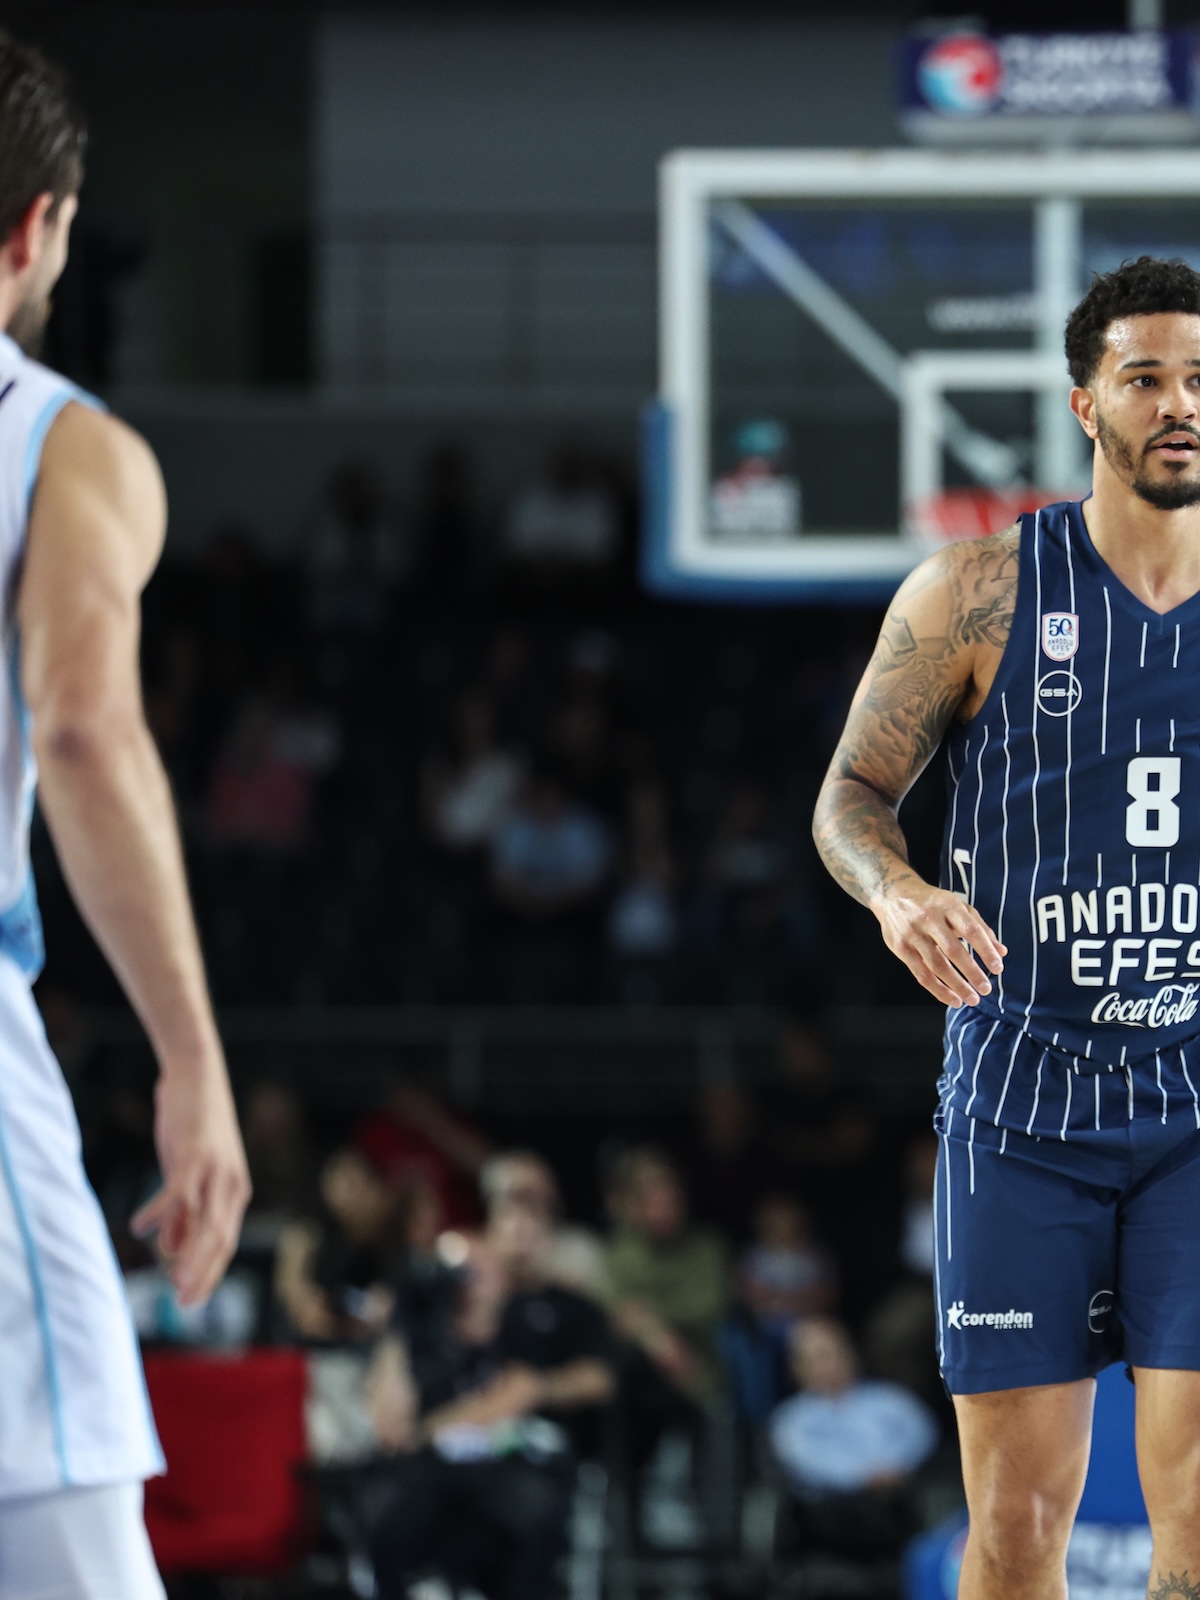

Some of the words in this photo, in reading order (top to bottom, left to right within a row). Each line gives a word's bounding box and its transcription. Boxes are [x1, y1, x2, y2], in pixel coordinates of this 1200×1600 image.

[1040, 688, 1078, 697] GSA
[1125, 757, 1181, 848] 8
[961, 1309, 1033, 1326] corendon
